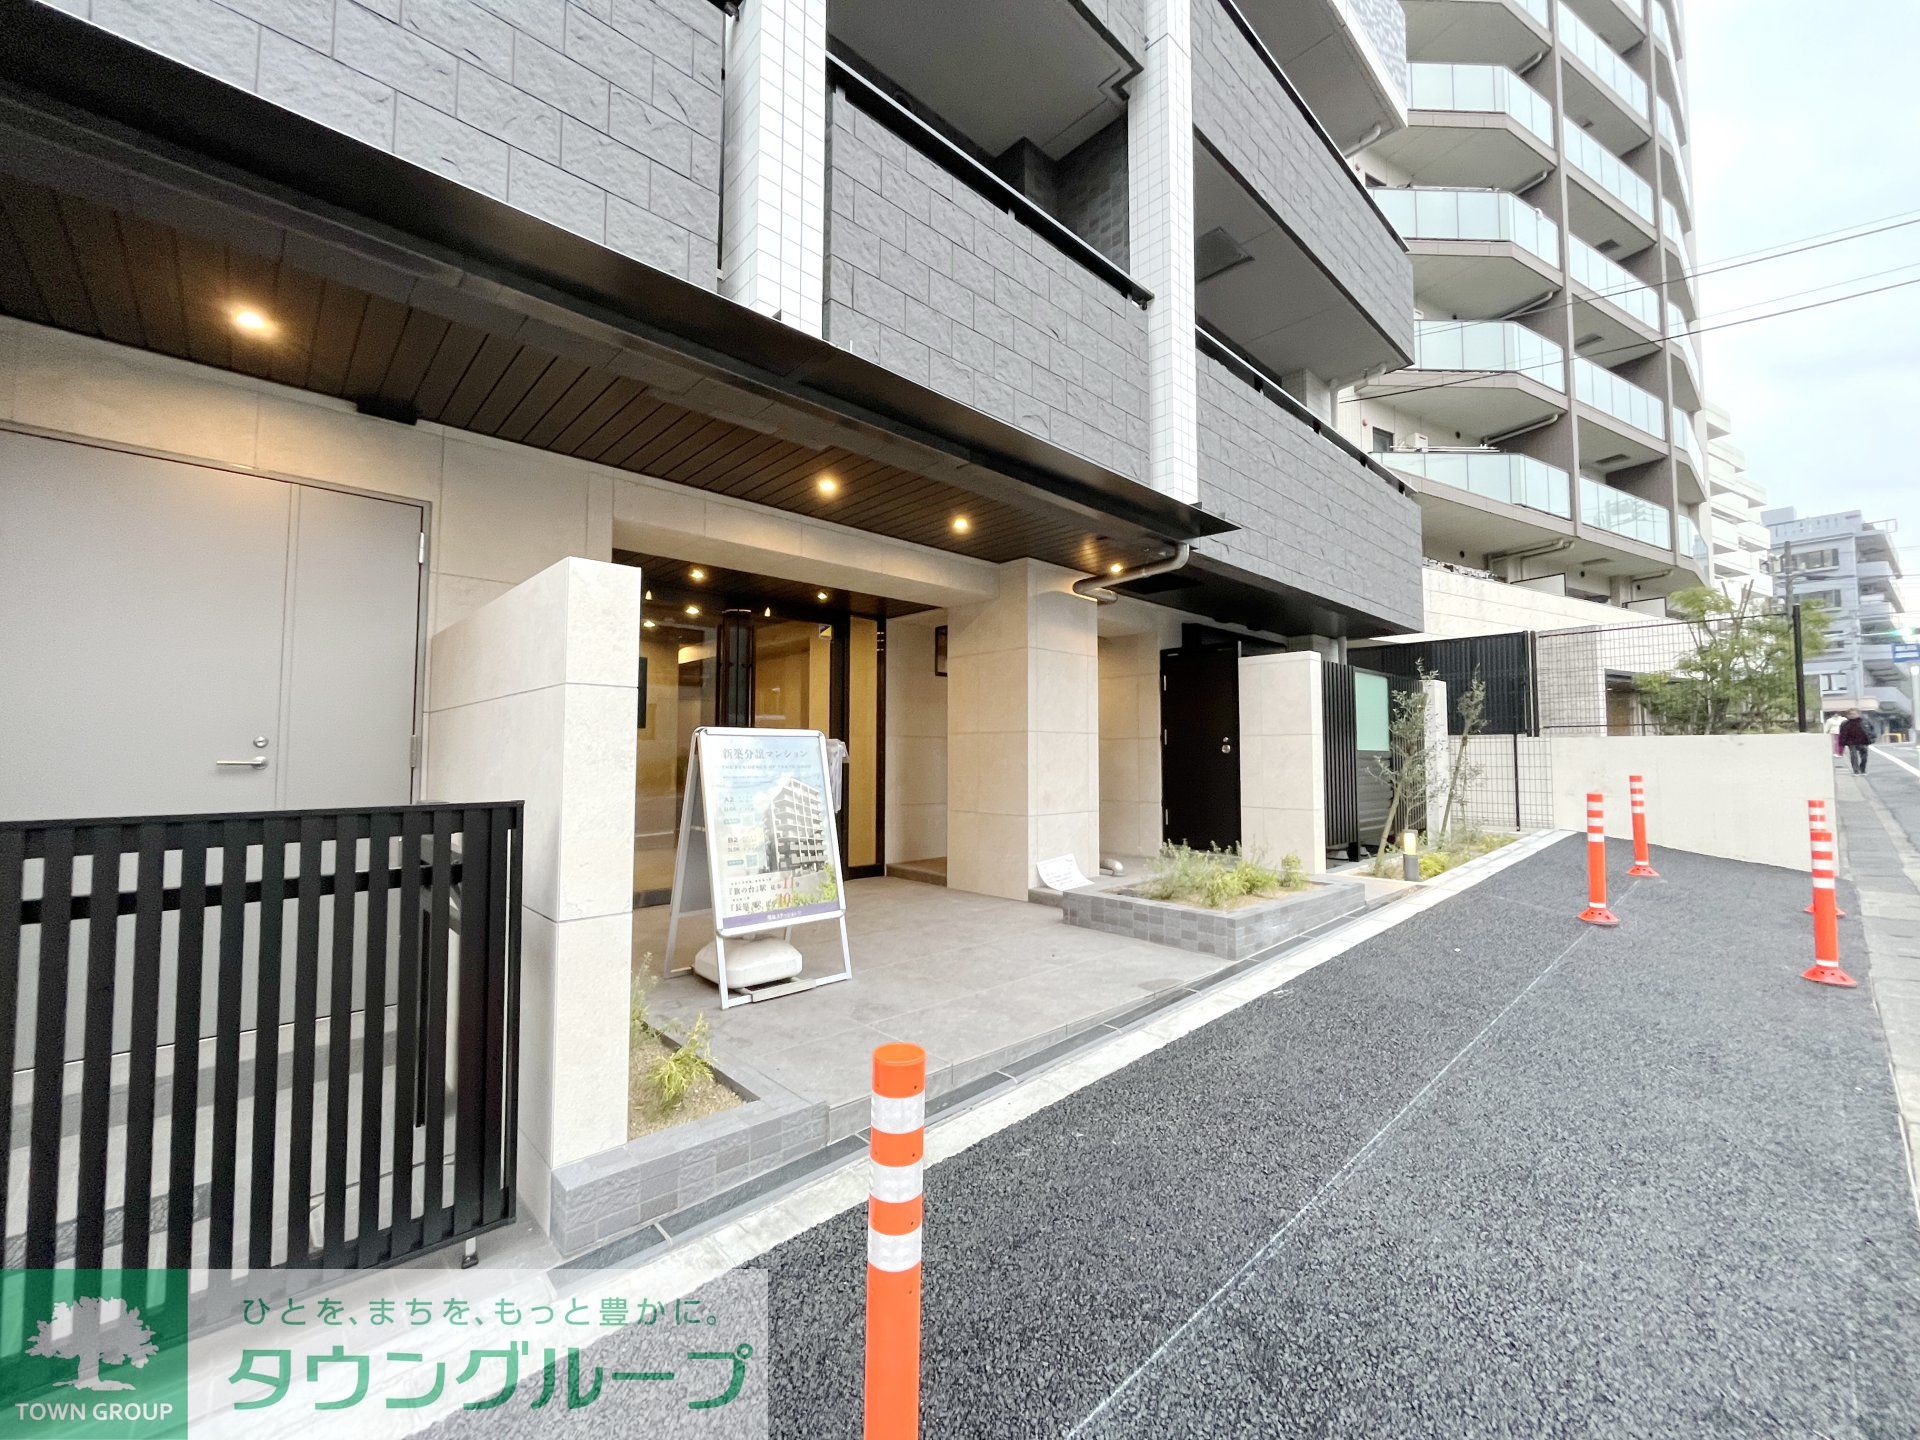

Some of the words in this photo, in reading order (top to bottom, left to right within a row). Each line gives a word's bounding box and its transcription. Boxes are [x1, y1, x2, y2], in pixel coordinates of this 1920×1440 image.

[722, 747, 808, 761] 新築分譲マンション
